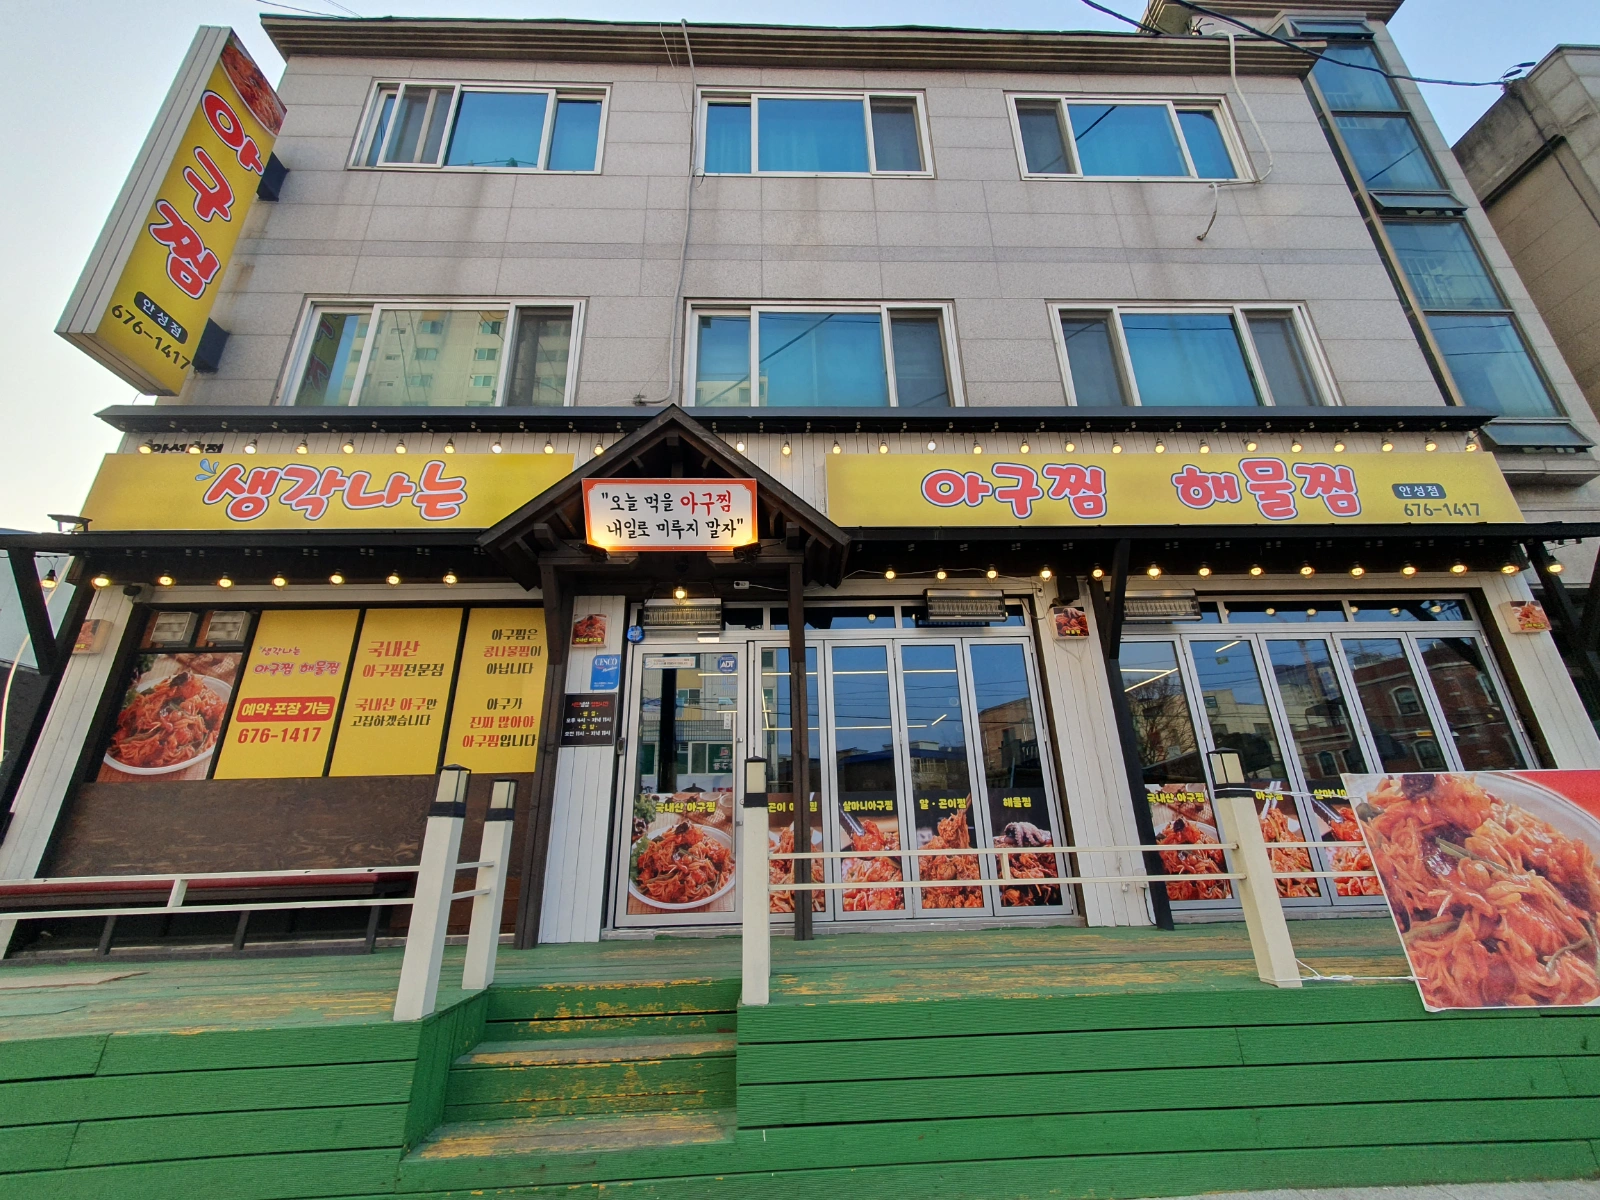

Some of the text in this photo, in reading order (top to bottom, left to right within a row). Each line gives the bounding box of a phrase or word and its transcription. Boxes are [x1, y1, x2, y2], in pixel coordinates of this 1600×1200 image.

[148, 90, 264, 299] 아구찜
[142, 298, 183, 338] 안성점
[111, 304, 191, 370] 676-1417
[203, 460, 466, 521] 생각나는
[922, 458, 1361, 520] 아구찜 해물찜
[1399, 485, 1439, 497] 안성점
[601, 490, 731, 516] "오늘 먹을 아구찜
[1404, 502, 1480, 517] 676-1417
[607, 518, 744, 540] 내일로 미루지 말자"
[492, 629, 538, 640] 아구찜은
[261, 646, 300, 656] 생각나는
[368, 641, 420, 657] 국내산
[483, 645, 541, 658] 콩나물찜이
[254, 660, 341, 676] 아구찜 해물찜
[486, 663, 534, 674] 아닙니다
[595, 658, 618, 666] CESCO
[721, 660, 735, 668] ADT
[363, 663, 444, 677] 아구찜전문점
[303, 702, 330, 715] 가능
[355, 698, 438, 711] 국내산 아구만
[487, 698, 523, 710] 아구가
[351, 714, 431, 727] 고집하겠습니다
[470, 716, 535, 729] 진짜 많아야
[237, 727, 321, 744] 676-1417
[462, 734, 537, 747] 아구찜입니다
[1003, 797, 1031, 808] 해물찜
[1147, 791, 1205, 803] 국내산 아구찜
[655, 802, 716, 813] 국내산 아구찜
[843, 801, 893, 812] 살마니아구찜
[919, 799, 929, 810] 알
[938, 799, 967, 809] 곤이찜
